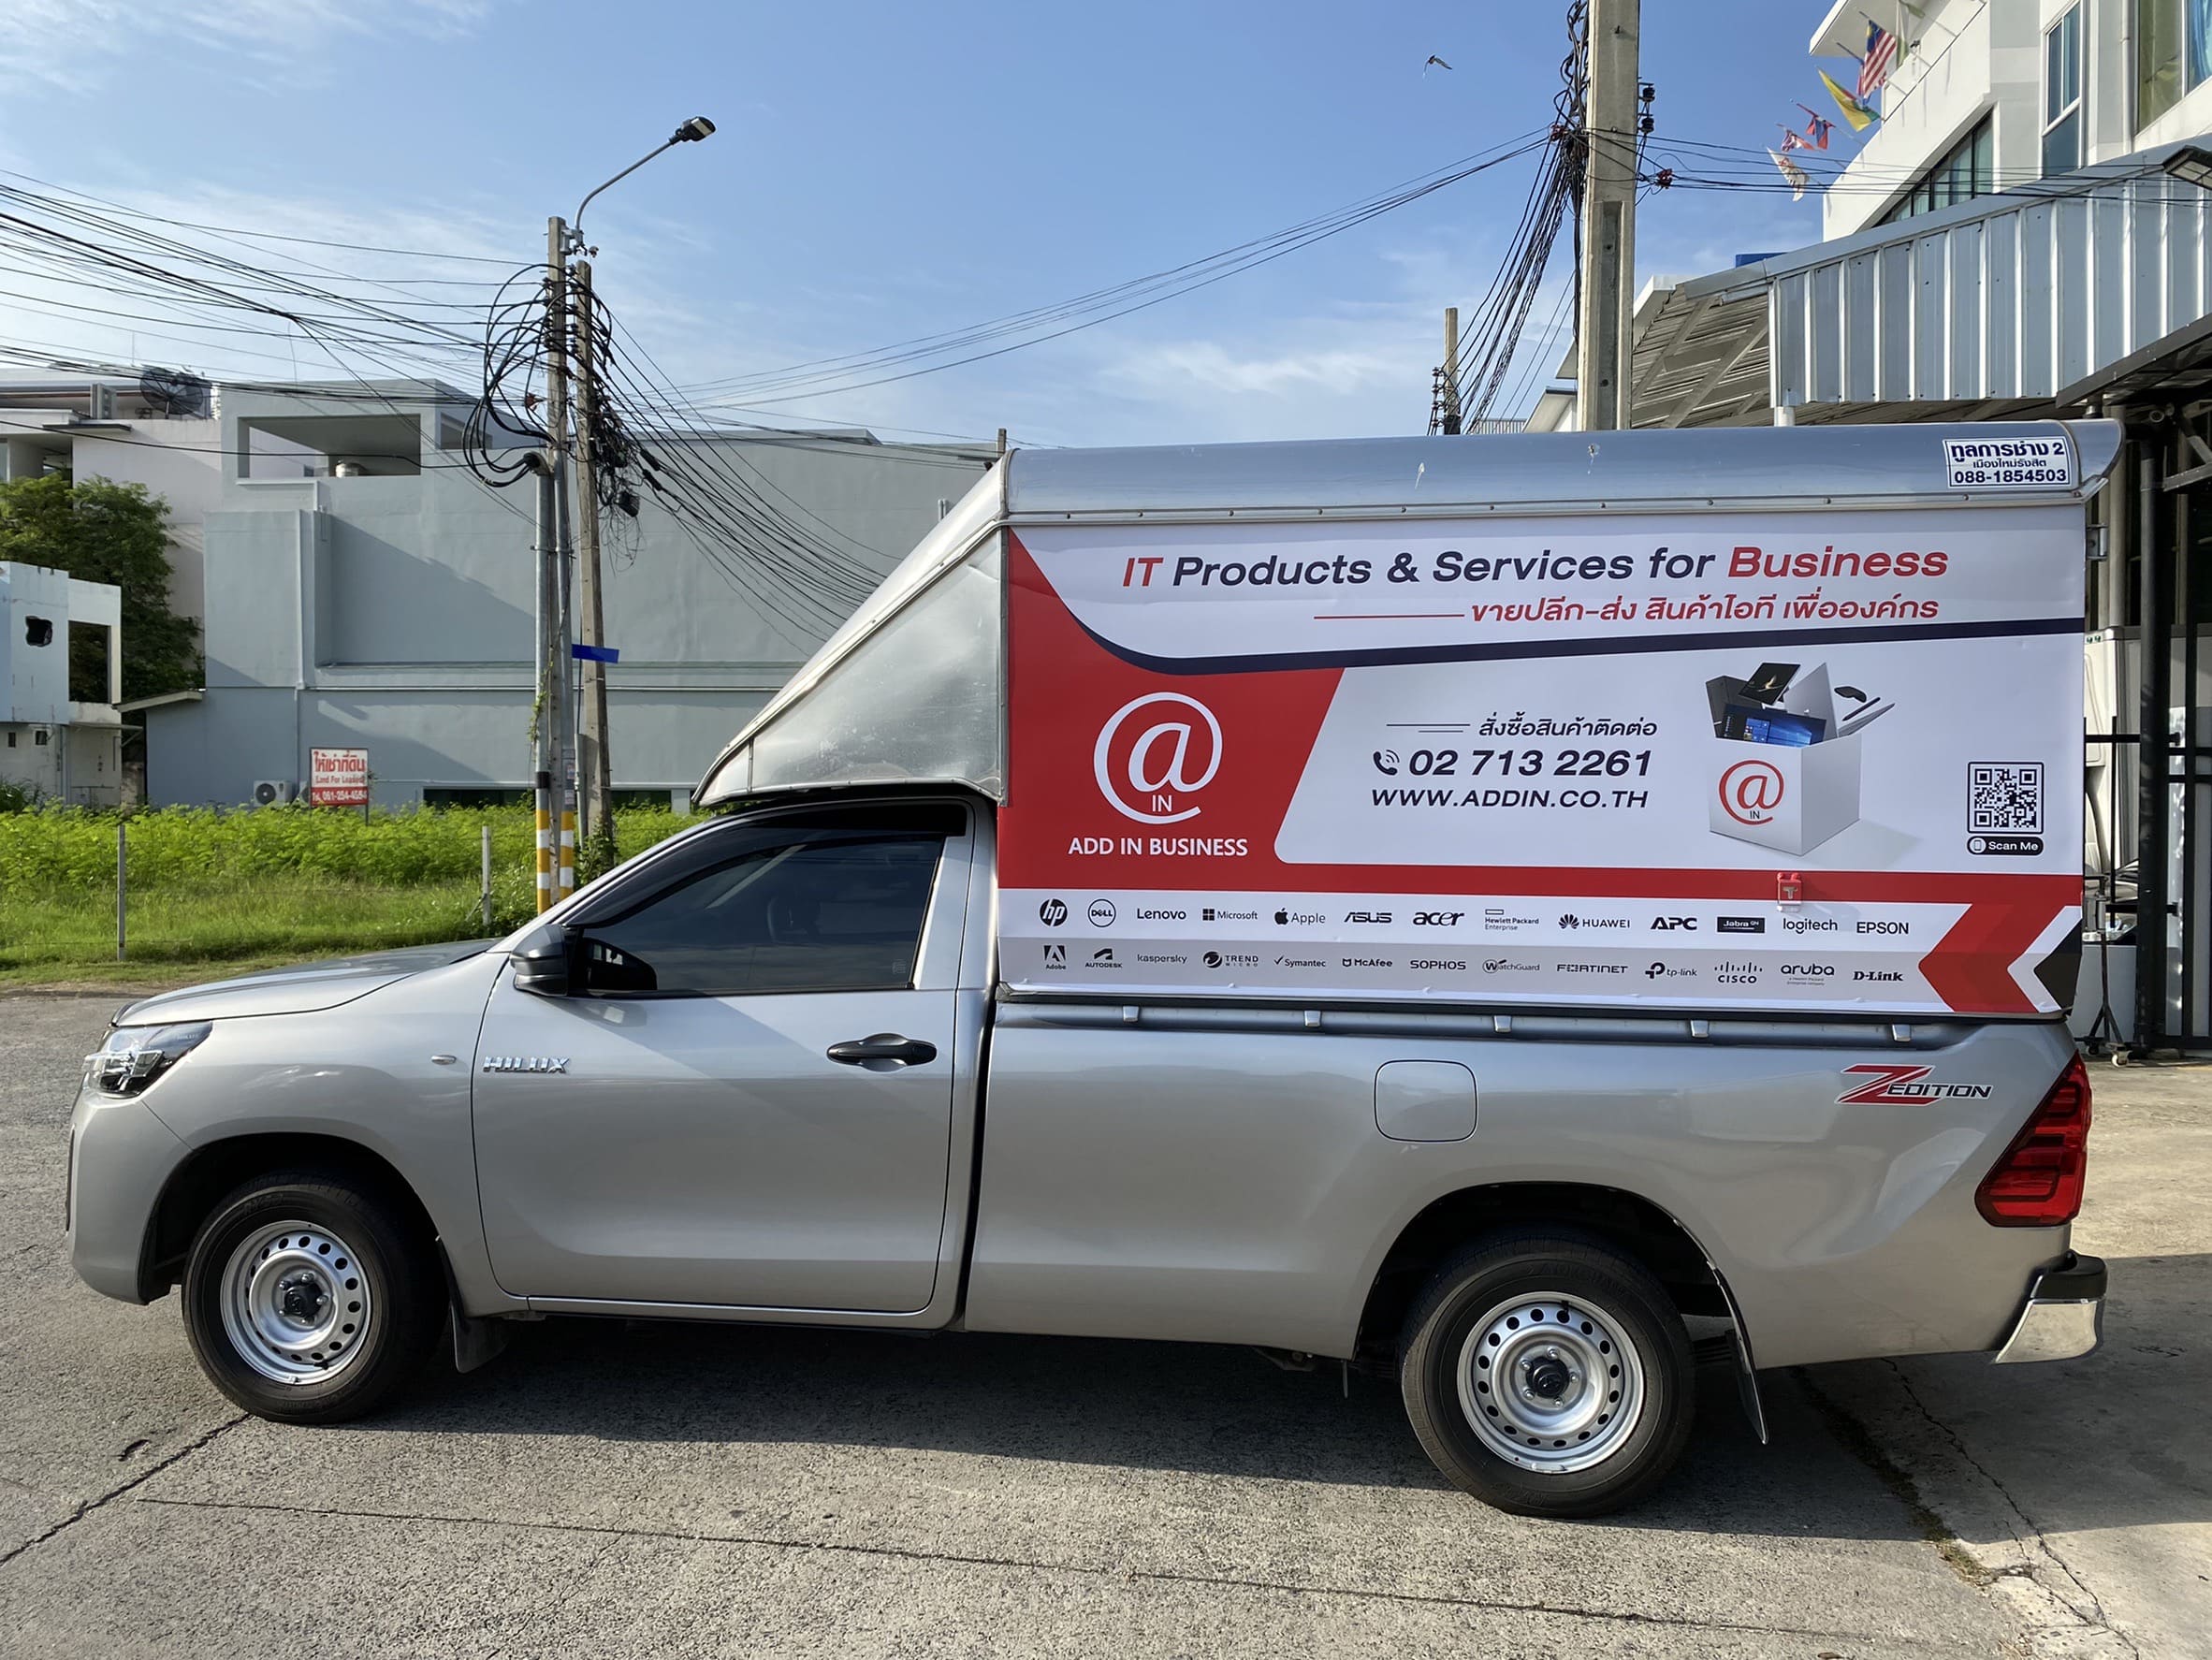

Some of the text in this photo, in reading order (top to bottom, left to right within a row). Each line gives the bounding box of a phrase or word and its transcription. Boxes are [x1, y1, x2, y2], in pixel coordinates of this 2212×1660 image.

[1951, 441, 2065, 462] ทูลการช่าง 2
[1954, 469, 2067, 484] 088-1854503
[1123, 545, 1949, 587] IT Products & Services for Business
[1472, 586, 1940, 622] ขายปลีก-ส่ง สินค้าไอที เพื่อองค์กร
[1478, 711, 1658, 737] สั่งซื้อสินค้าติดต่อ
[1408, 749, 1652, 777] 02 713 2261
[1152, 794, 1172, 812] IN
[1371, 789, 1649, 808] WWW.ADDIN.CO.TH
[1749, 809, 1761, 821] IN
[1068, 837, 1249, 857] ADD IN BUSINESS
[1987, 840, 2040, 852] Scan Me
[1041, 898, 1068, 927] hp
[1136, 908, 1187, 921] Lenovo
[1216, 910, 1259, 921] Microsoft
[1290, 911, 1326, 925] Apple
[1344, 911, 1393, 925] ASUS
[1412, 911, 1465, 926] acer
[1512, 917, 1540, 925] Packard
[1581, 918, 1631, 928] HUAWEI
[1650, 916, 1698, 931] APC
[1783, 918, 1839, 935] logitech
[1855, 921, 1910, 935] EPSON
[1137, 954, 1188, 965] kaspersky
[1225, 954, 1259, 963] TREND
[1284, 958, 1327, 968] Symantec
[1354, 958, 1393, 968] McAfee
[1409, 959, 1467, 970] SOPHOS
[1482, 959, 1540, 974] WatchGuard
[1557, 964, 1629, 974] FORTINET
[1666, 968, 1697, 978] tp-link
[1781, 963, 1836, 977] aruba
[1853, 970, 1904, 982] D-Link
[483, 1056, 570, 1073] HILUX
[1886, 1082, 1994, 1099] EDITION
